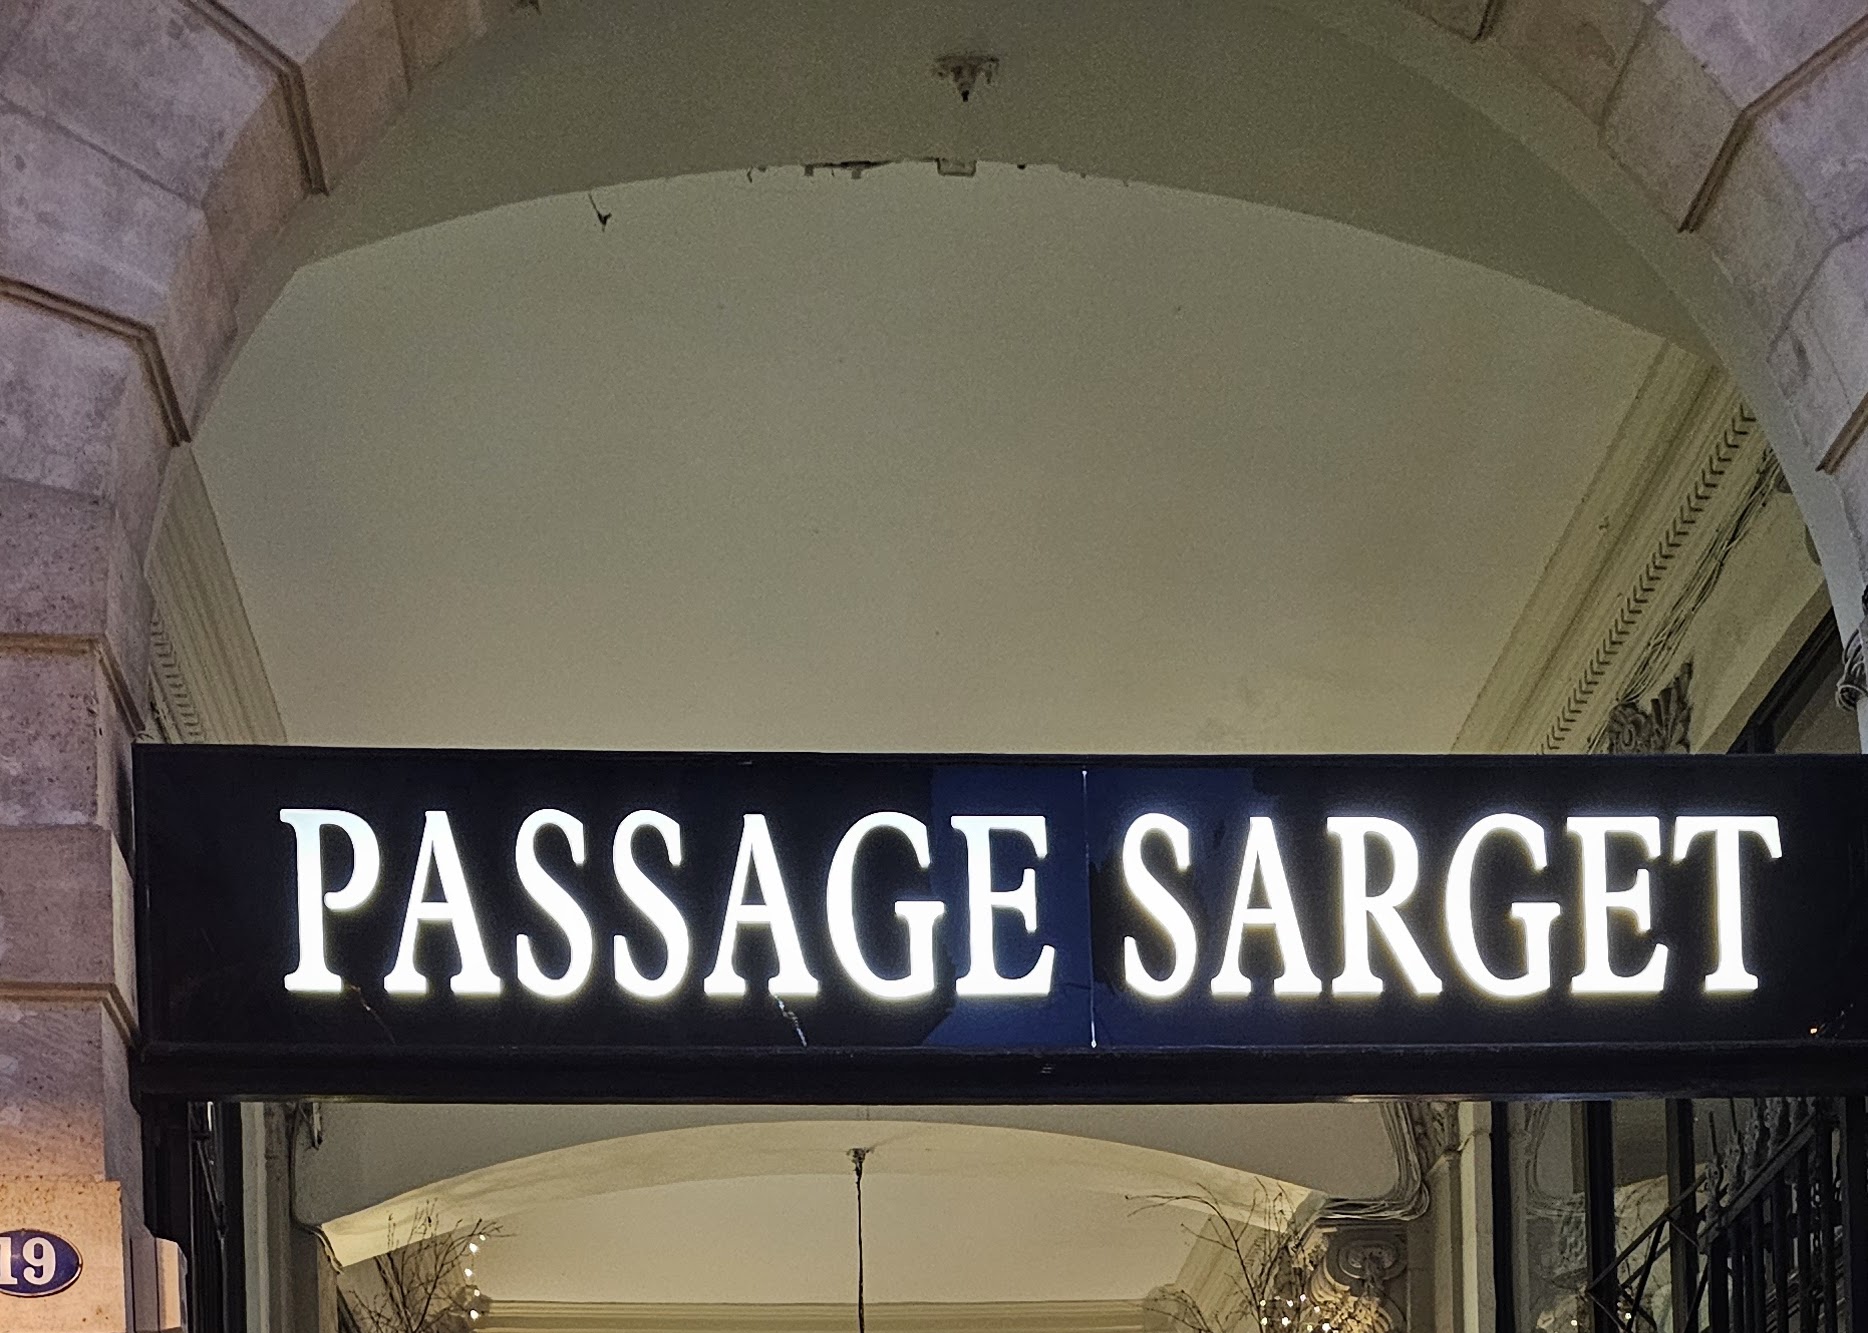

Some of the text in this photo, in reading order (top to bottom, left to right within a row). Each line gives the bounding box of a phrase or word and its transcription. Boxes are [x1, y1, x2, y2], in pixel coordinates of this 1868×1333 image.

[279, 806, 1784, 999] PASSAGE SARGET
[0, 1236, 57, 1286] 19
